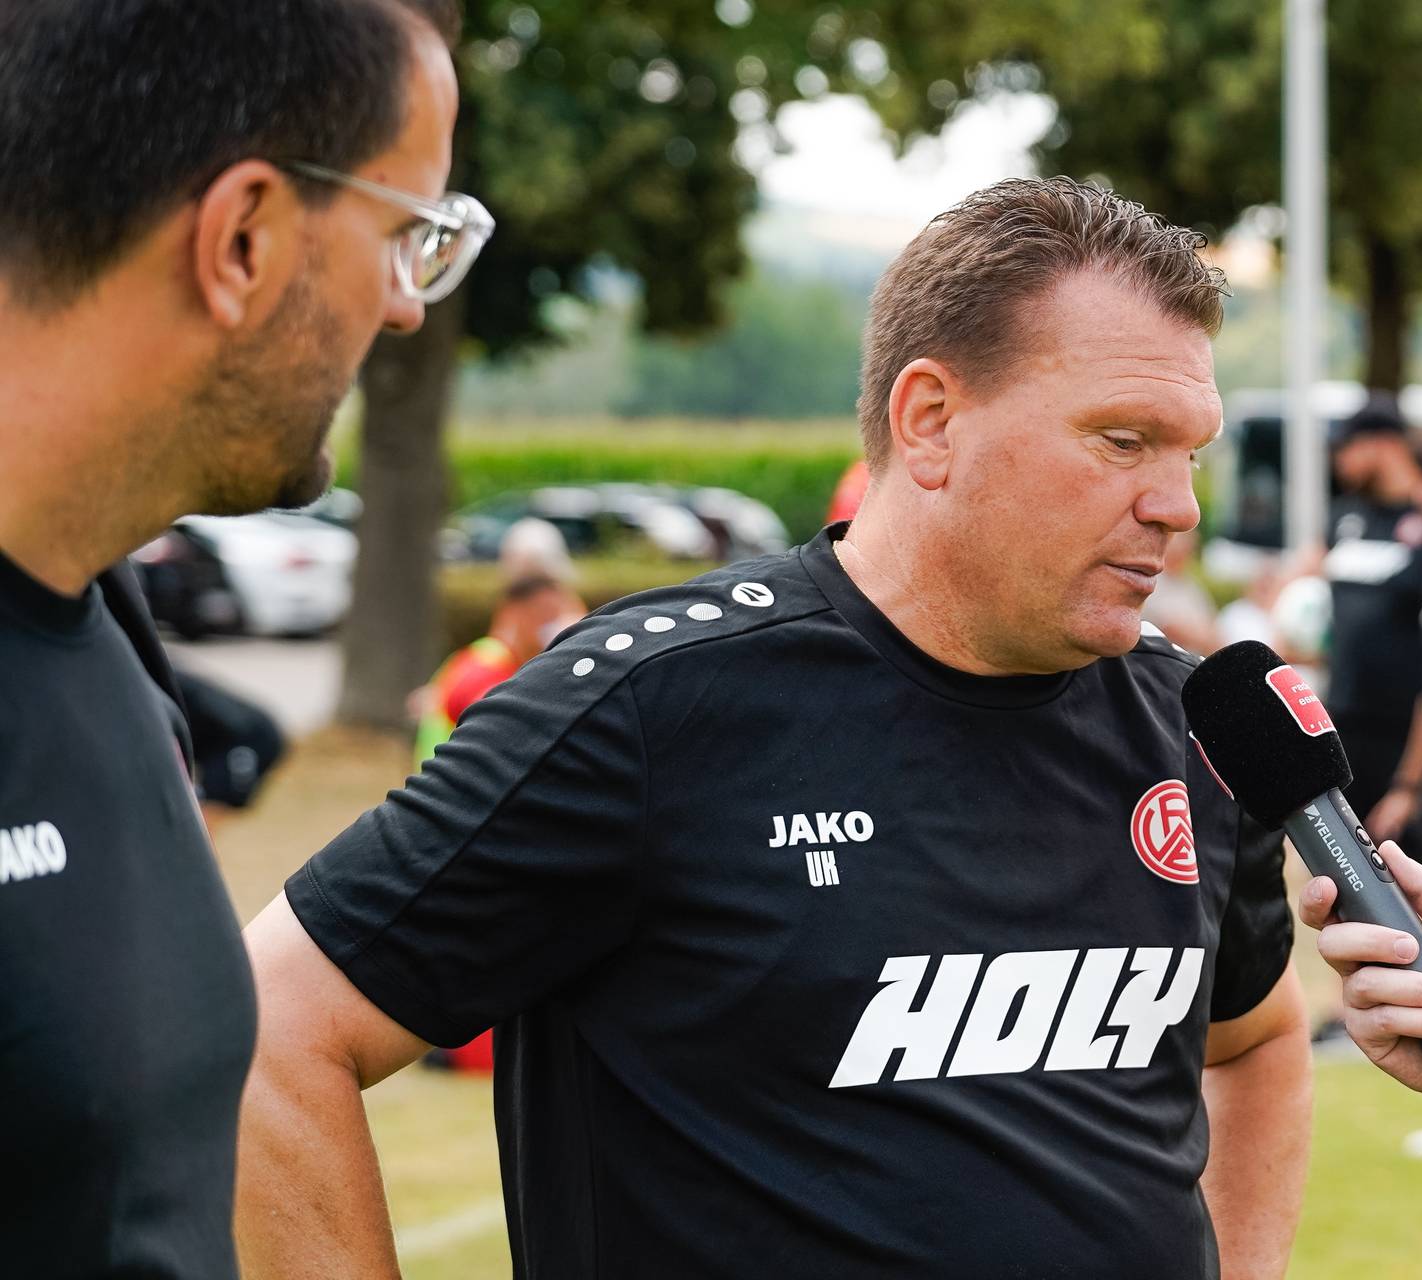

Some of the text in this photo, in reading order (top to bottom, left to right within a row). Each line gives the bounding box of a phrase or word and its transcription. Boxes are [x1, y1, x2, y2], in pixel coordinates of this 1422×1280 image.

[0, 821, 67, 884] AKO
[768, 810, 875, 848] JAKO
[1313, 816, 1364, 892] YELLOWTEC
[805, 850, 840, 887] UK
[828, 947, 1205, 1089] HOLY
